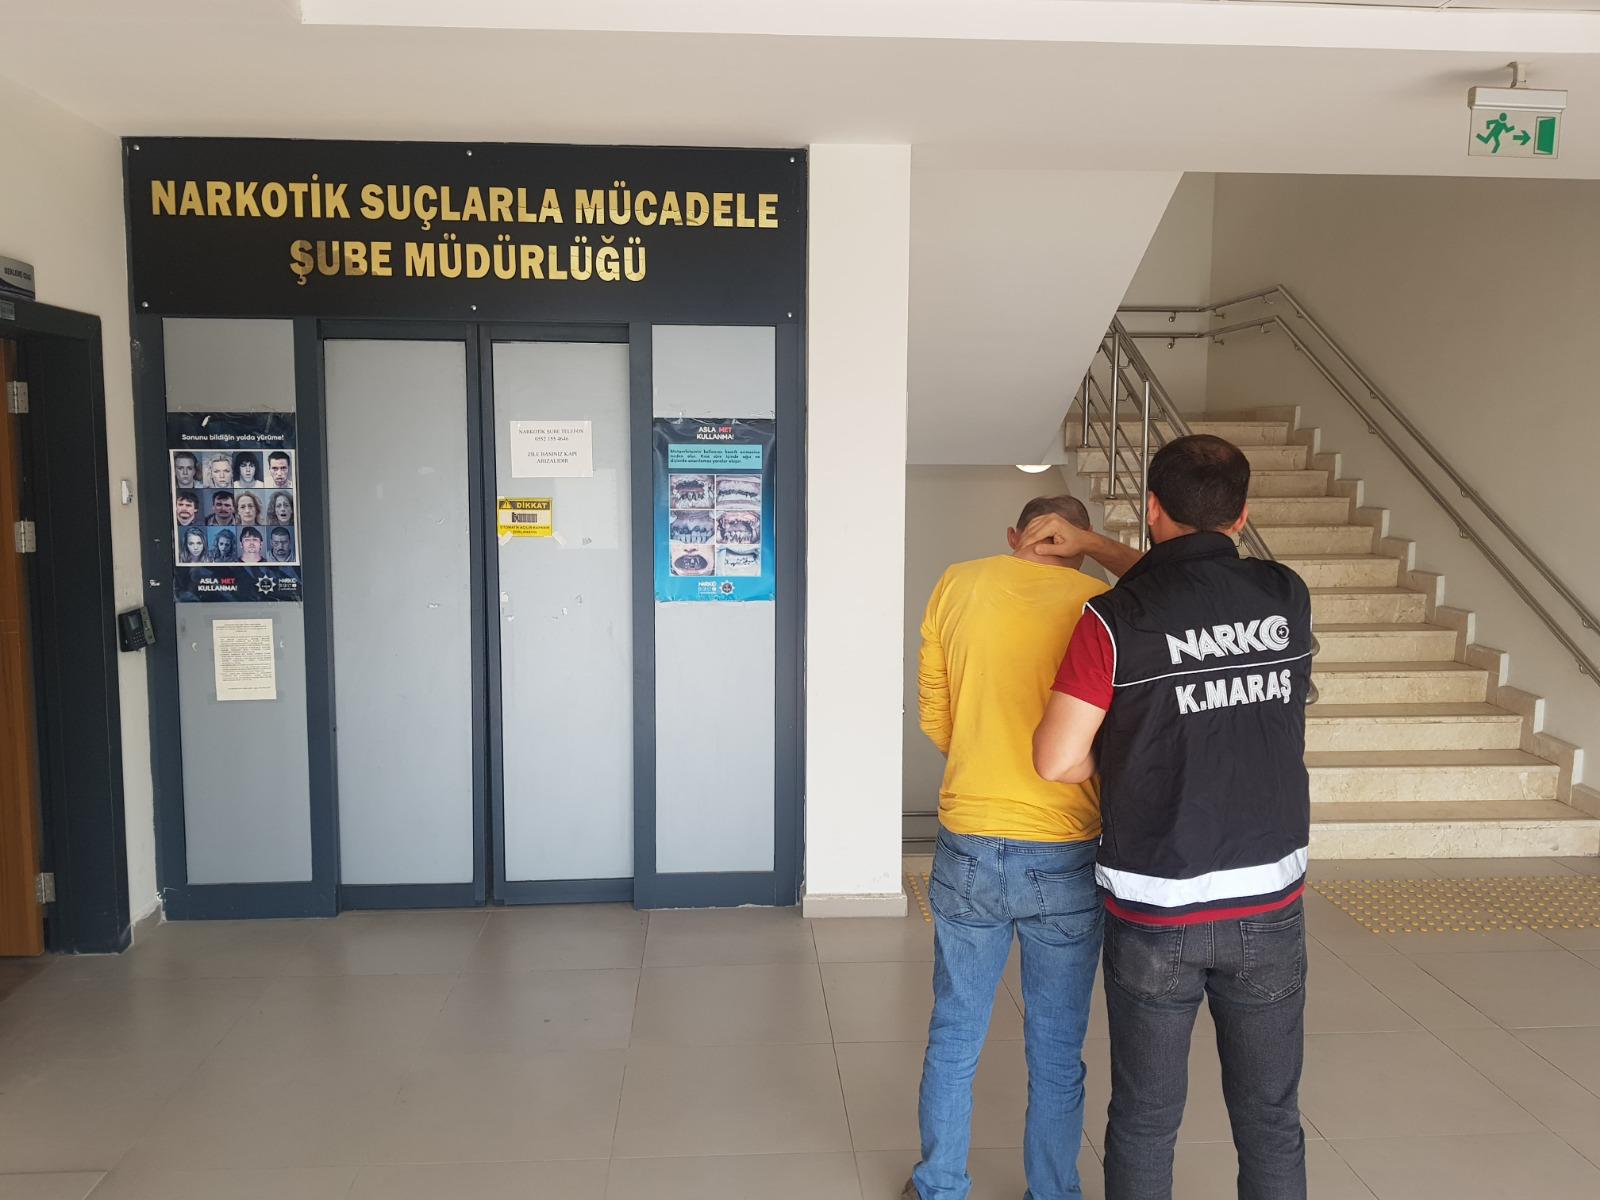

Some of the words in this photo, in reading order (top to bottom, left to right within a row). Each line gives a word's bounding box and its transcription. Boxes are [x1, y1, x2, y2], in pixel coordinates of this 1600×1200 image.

[151, 173, 351, 219] NARKOTİK
[360, 183, 563, 231] SUÇLARLA
[575, 180, 779, 228] MÜCADELE
[289, 240, 393, 286] ŞUBE
[404, 232, 646, 282] MÜDÜRLÜĞÜ
[209, 434, 235, 442] bildiğin
[236, 434, 256, 442] yolda
[256, 434, 284, 442] yürüme!
[1175, 669, 1292, 714] K.MARAŞ
